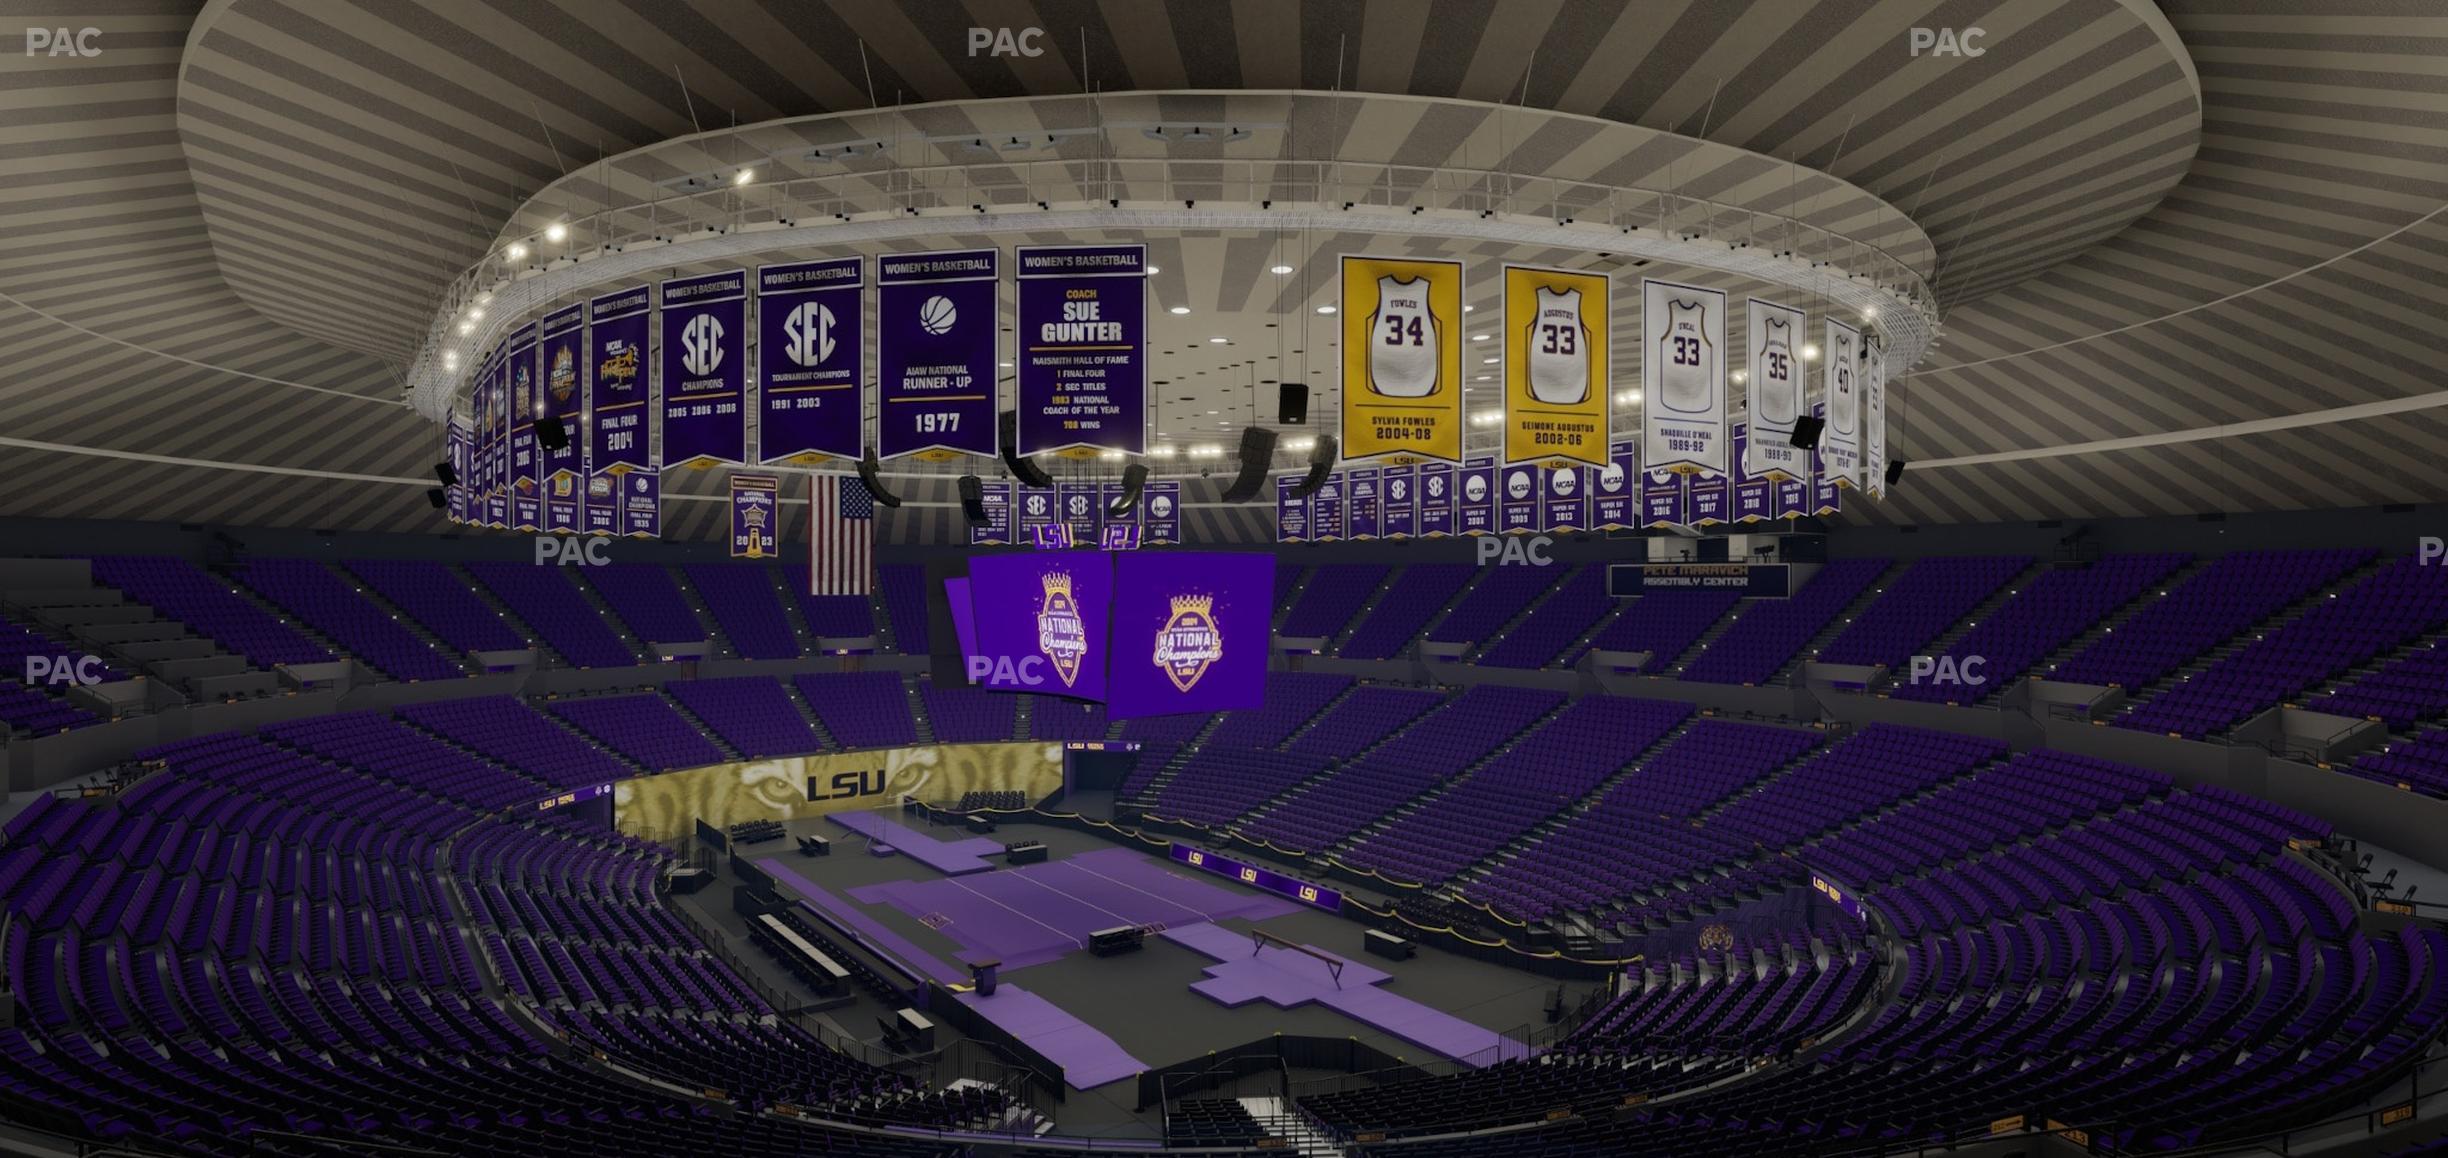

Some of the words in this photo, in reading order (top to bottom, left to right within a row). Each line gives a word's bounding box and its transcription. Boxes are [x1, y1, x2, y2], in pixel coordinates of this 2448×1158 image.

[885, 262, 930, 275] WOMEN'S
[932, 259, 991, 272] BASKETBALL
[1025, 256, 1073, 267] WOMEN'S
[1075, 254, 1138, 266] BASKETBALL
[764, 271, 803, 285] WOMEN'S
[805, 267, 856, 282] BASKETBALL
[666, 286, 697, 299] WOMEN'S
[699, 280, 741, 295] BASKETBALL
[1066, 289, 1096, 299] COACH
[1063, 301, 1100, 321] SUE
[1390, 299, 1417, 309] FOWLES
[784, 301, 837, 367] SEC
[1041, 322, 1122, 342] GUNTER
[1385, 315, 1423, 346] 34
[681, 313, 725, 376] SEC
[1543, 325, 1575, 355] 33
[1674, 336, 1699, 366] 33
[1032, 357, 1072, 365] NAISMITH
[1073, 356, 1094, 365] HALL
[1094, 356, 1106, 364] OF
[1107, 355, 1129, 364] FAME
[1769, 352, 1787, 380] 35
[772, 373, 812, 382] TOURNAMENT
[813, 370, 850, 380] CHAMPIONS
[906, 366, 927, 376] AIAW
[928, 365, 968, 375] NATIONAL
[1057, 370, 1061, 378] 1
[1063, 370, 1083, 378] FINAL
[682, 379, 724, 392] CHAMPIONS
[903, 376, 948, 390] RUNNER
[956, 375, 973, 388] UP
[1065, 383, 1080, 391] SEC
[1082, 382, 1106, 391] TITLES
[1838, 367, 1849, 394] 40
[772, 400, 791, 410] 1991
[797, 397, 821, 408] 2003
[1073, 395, 1110, 404] NATIONAL
[668, 407, 687, 418] 2005
[1043, 406, 1069, 415] COACH
[1071, 406, 1082, 415] OF
[1083, 406, 1098, 414] THE
[1100, 405, 1120, 414] YEAR
[601, 417, 619, 430] FINAL
[620, 414, 638, 427] FOUR
[915, 413, 960, 432] 1977
[1080, 420, 1101, 429] WINS
[1372, 417, 1400, 425] SYLVIA
[1402, 417, 1435, 426] FOWLES
[1557, 423, 1594, 432] AUGUSTUS
[608, 431, 633, 452] 2004
[1376, 428, 1431, 440] 2004-08
[1535, 433, 1582, 445] 2002-06
[1550, 460, 1568, 468] LSU
[1027, 495, 1046, 515] SEC
[1069, 495, 1089, 515] SEC
[1643, 566, 1677, 576] PETE
[1679, 566, 1748, 576] MARAVICH
[1643, 577, 1700, 586] ASSEMBLY
[1703, 577, 1748, 586] CENTER
[1159, 632, 1217, 647] NATIONAL
[1158, 646, 1219, 665] Champions
[807, 770, 885, 801] LSU
[539, 799, 556, 810] LSU
[1188, 851, 1203, 865] LSU
[1241, 867, 1257, 882] LSU
[1812, 876, 1828, 892] LSU
[1299, 886, 1317, 902] LSU
